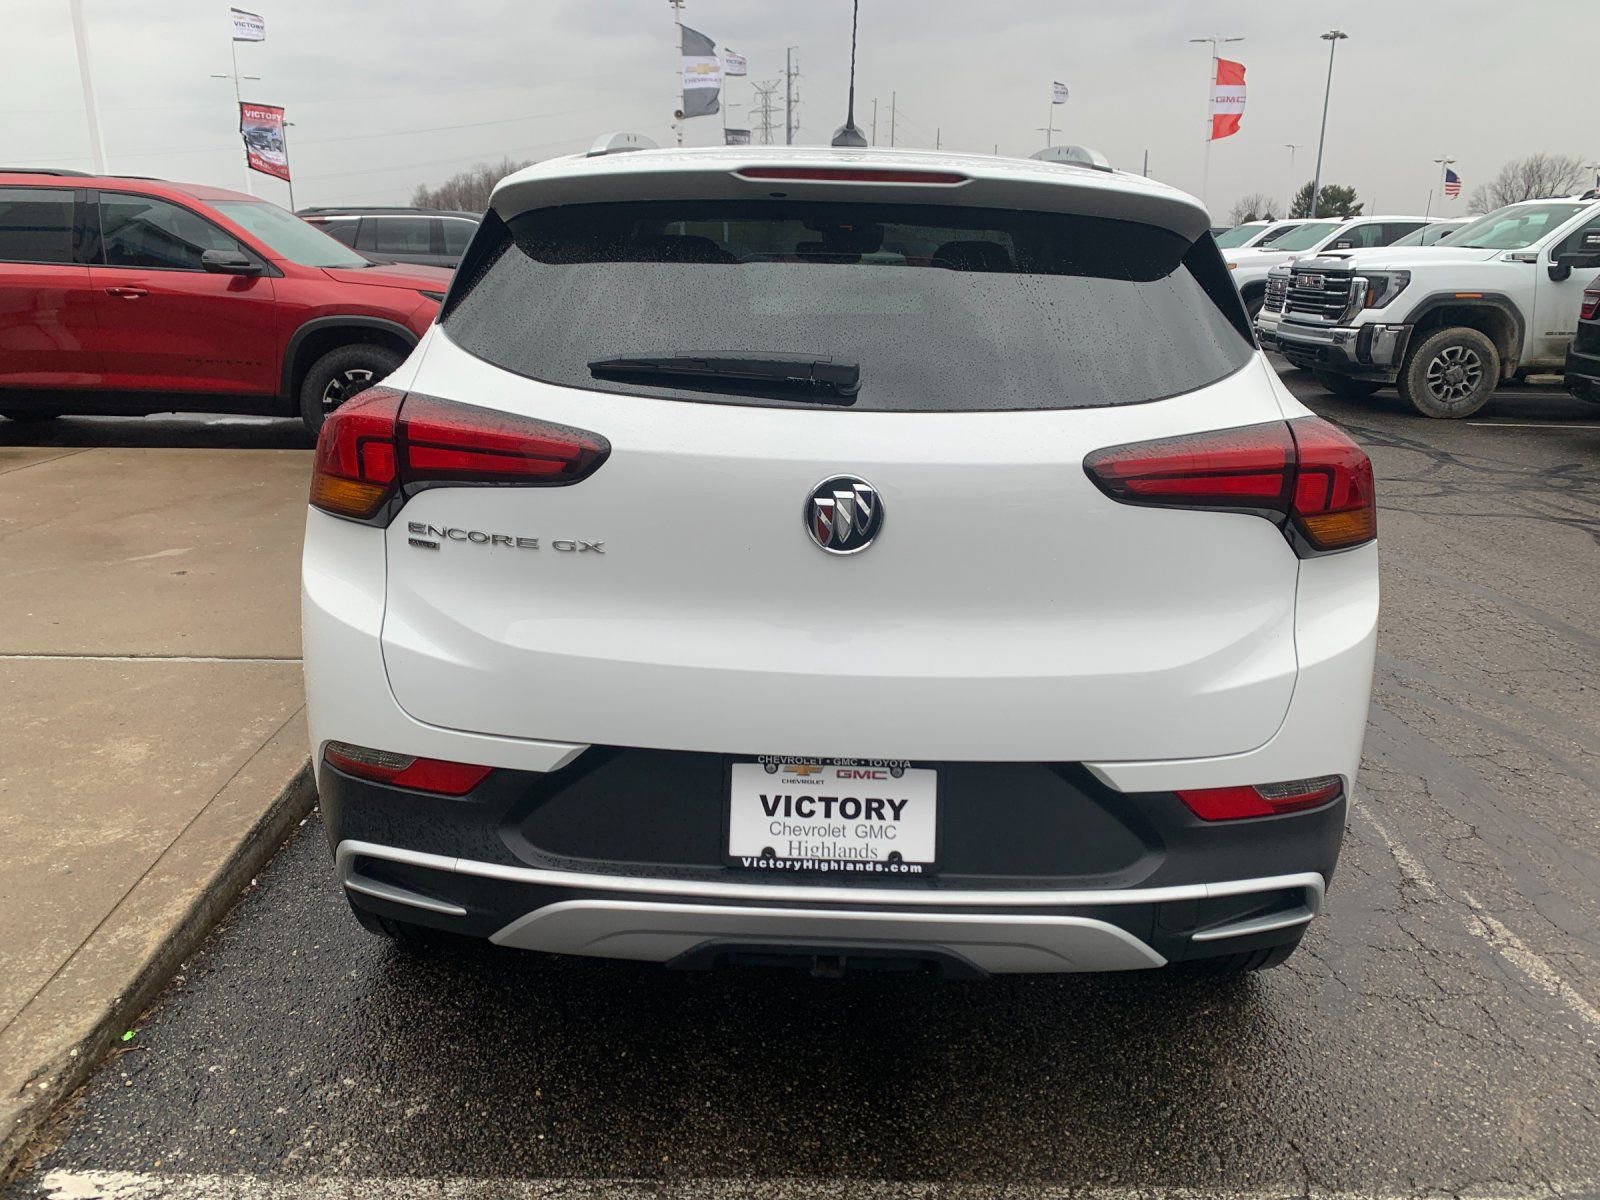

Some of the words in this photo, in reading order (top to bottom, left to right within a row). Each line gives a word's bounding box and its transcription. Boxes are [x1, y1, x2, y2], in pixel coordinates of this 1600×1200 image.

[233, 19, 264, 30] VICTORY
[244, 109, 282, 121] VICTORY
[408, 521, 539, 549] ENCORE
[552, 539, 605, 554] GX
[757, 755, 824, 765] CHEVROLET
[833, 758, 858, 767] GMC
[868, 759, 911, 768] TOYOTA
[836, 769, 888, 780] GMC
[759, 794, 909, 822] VICTORY
[769, 821, 846, 838] Chevrolet
[855, 824, 897, 839] GMC
[787, 840, 878, 860] Highlands
[742, 857, 922, 873] VictoryHighlands.com
